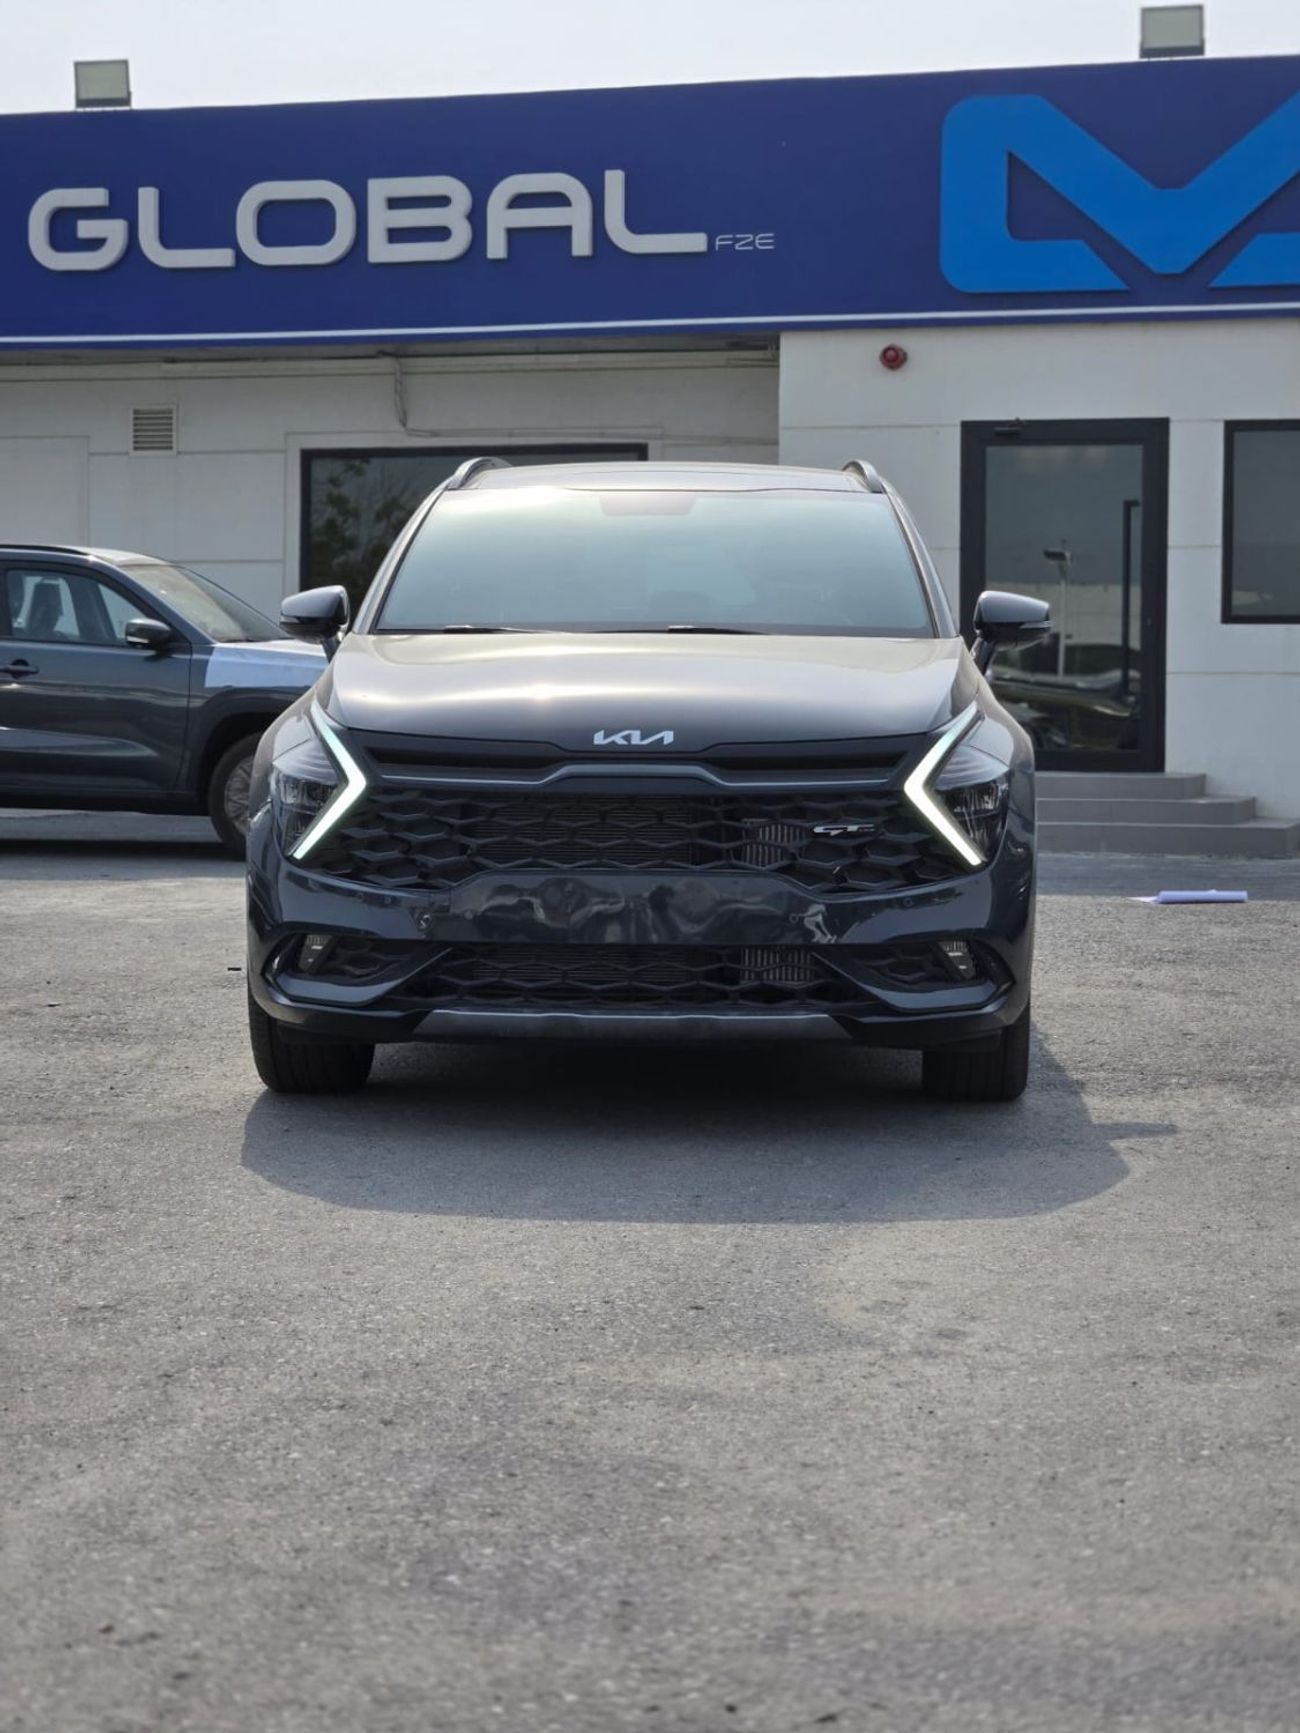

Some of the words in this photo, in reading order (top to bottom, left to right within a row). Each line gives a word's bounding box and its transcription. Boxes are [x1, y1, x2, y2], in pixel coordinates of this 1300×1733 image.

[27, 169, 708, 272] GLOBAL
[715, 233, 775, 251] FZE
[593, 729, 674, 745] KIA
